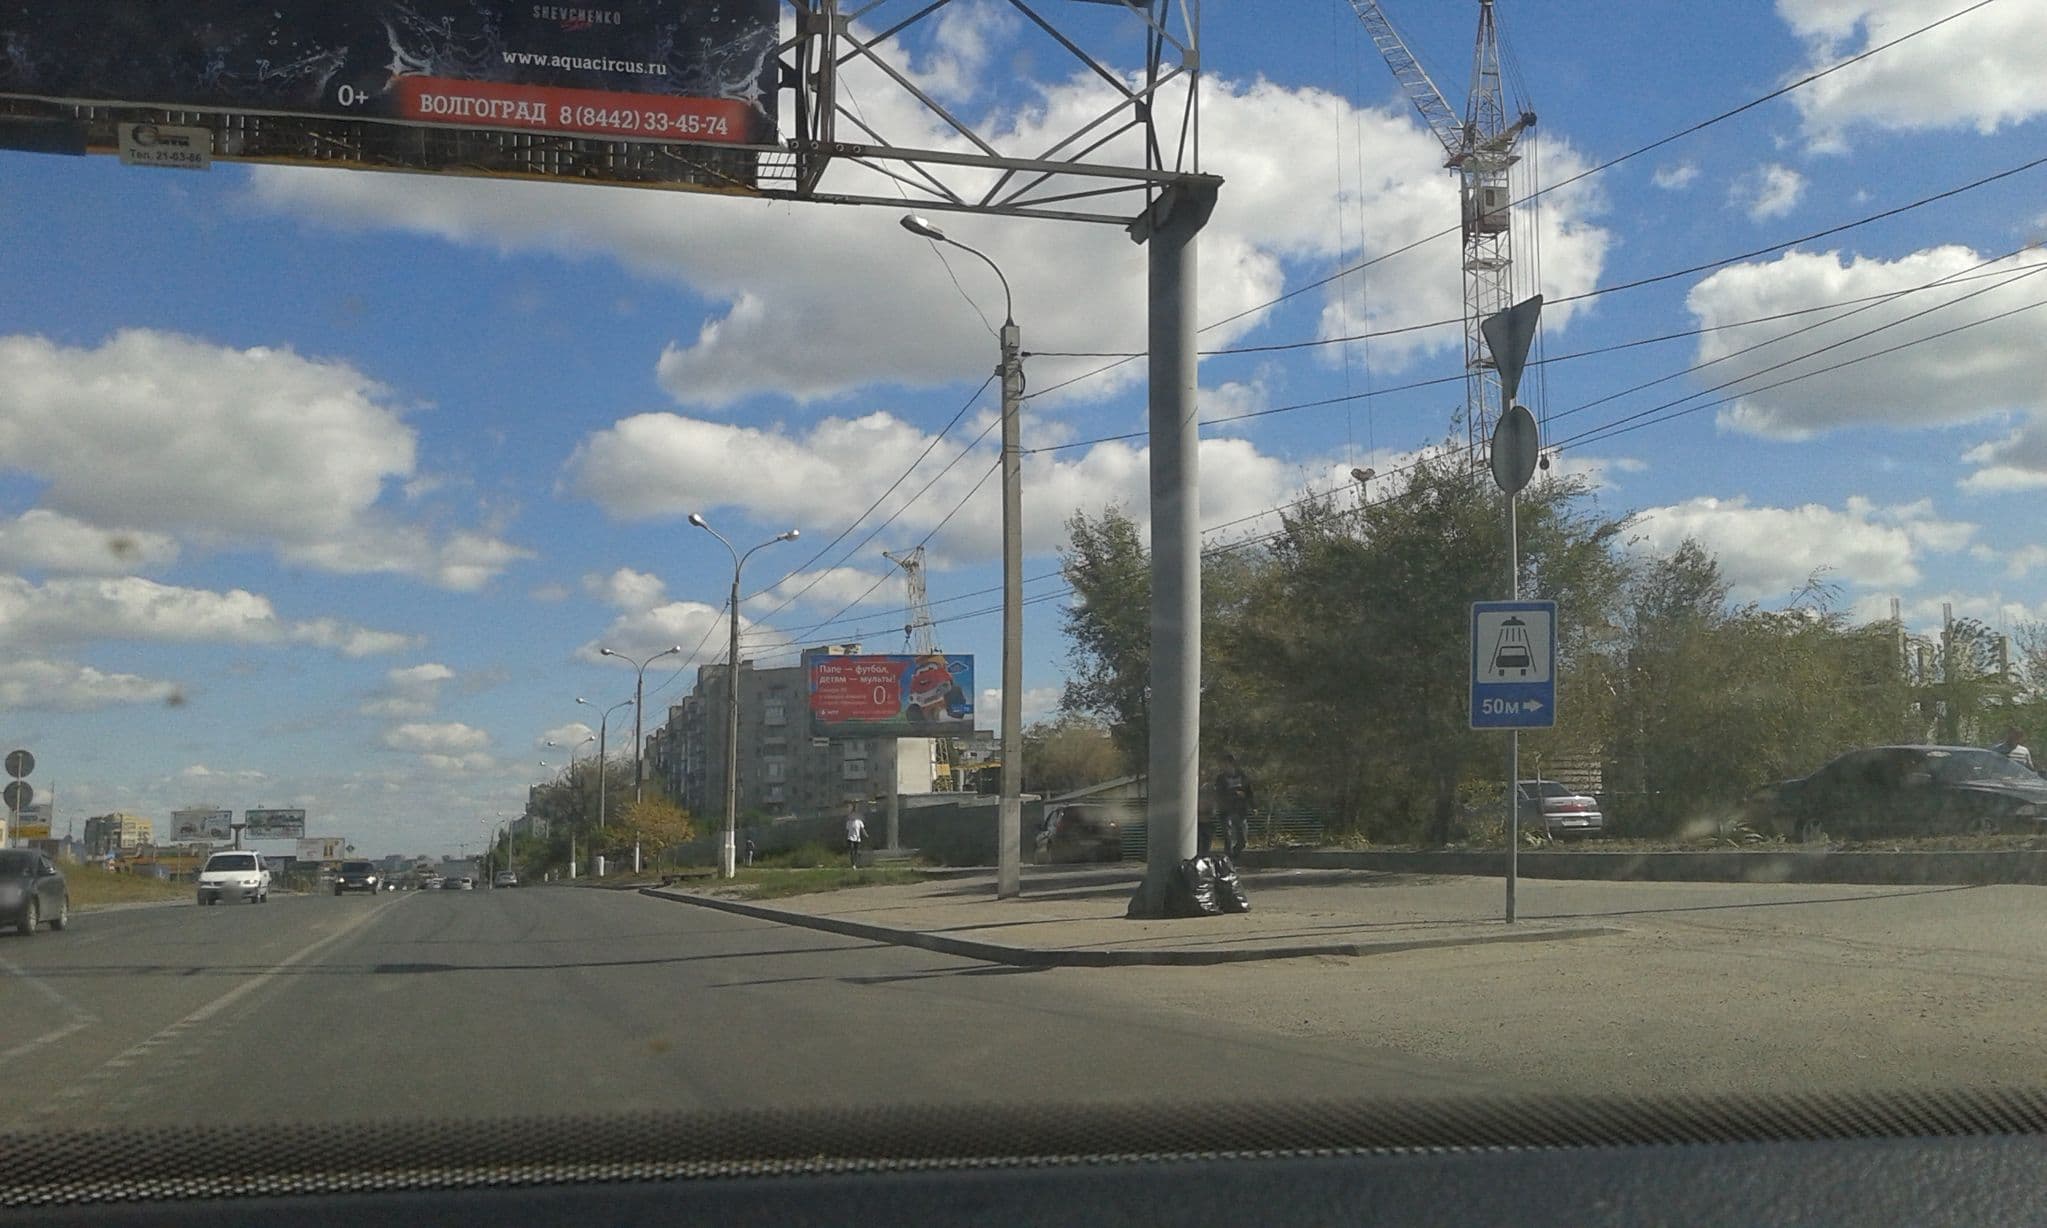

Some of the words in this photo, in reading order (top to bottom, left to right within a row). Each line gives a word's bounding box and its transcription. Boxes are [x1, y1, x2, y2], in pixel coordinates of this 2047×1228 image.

[532, 4, 621, 26] SHEVCHENKO
[502, 51, 667, 75] www.aquacircus.ru
[337, 84, 369, 106] 0+
[419, 94, 547, 125] ВОЛГОГРАД
[644, 112, 728, 135] 33-45-74
[819, 664, 842, 674] Папе
[819, 675, 847, 685] детям
[873, 685, 886, 705] 0
